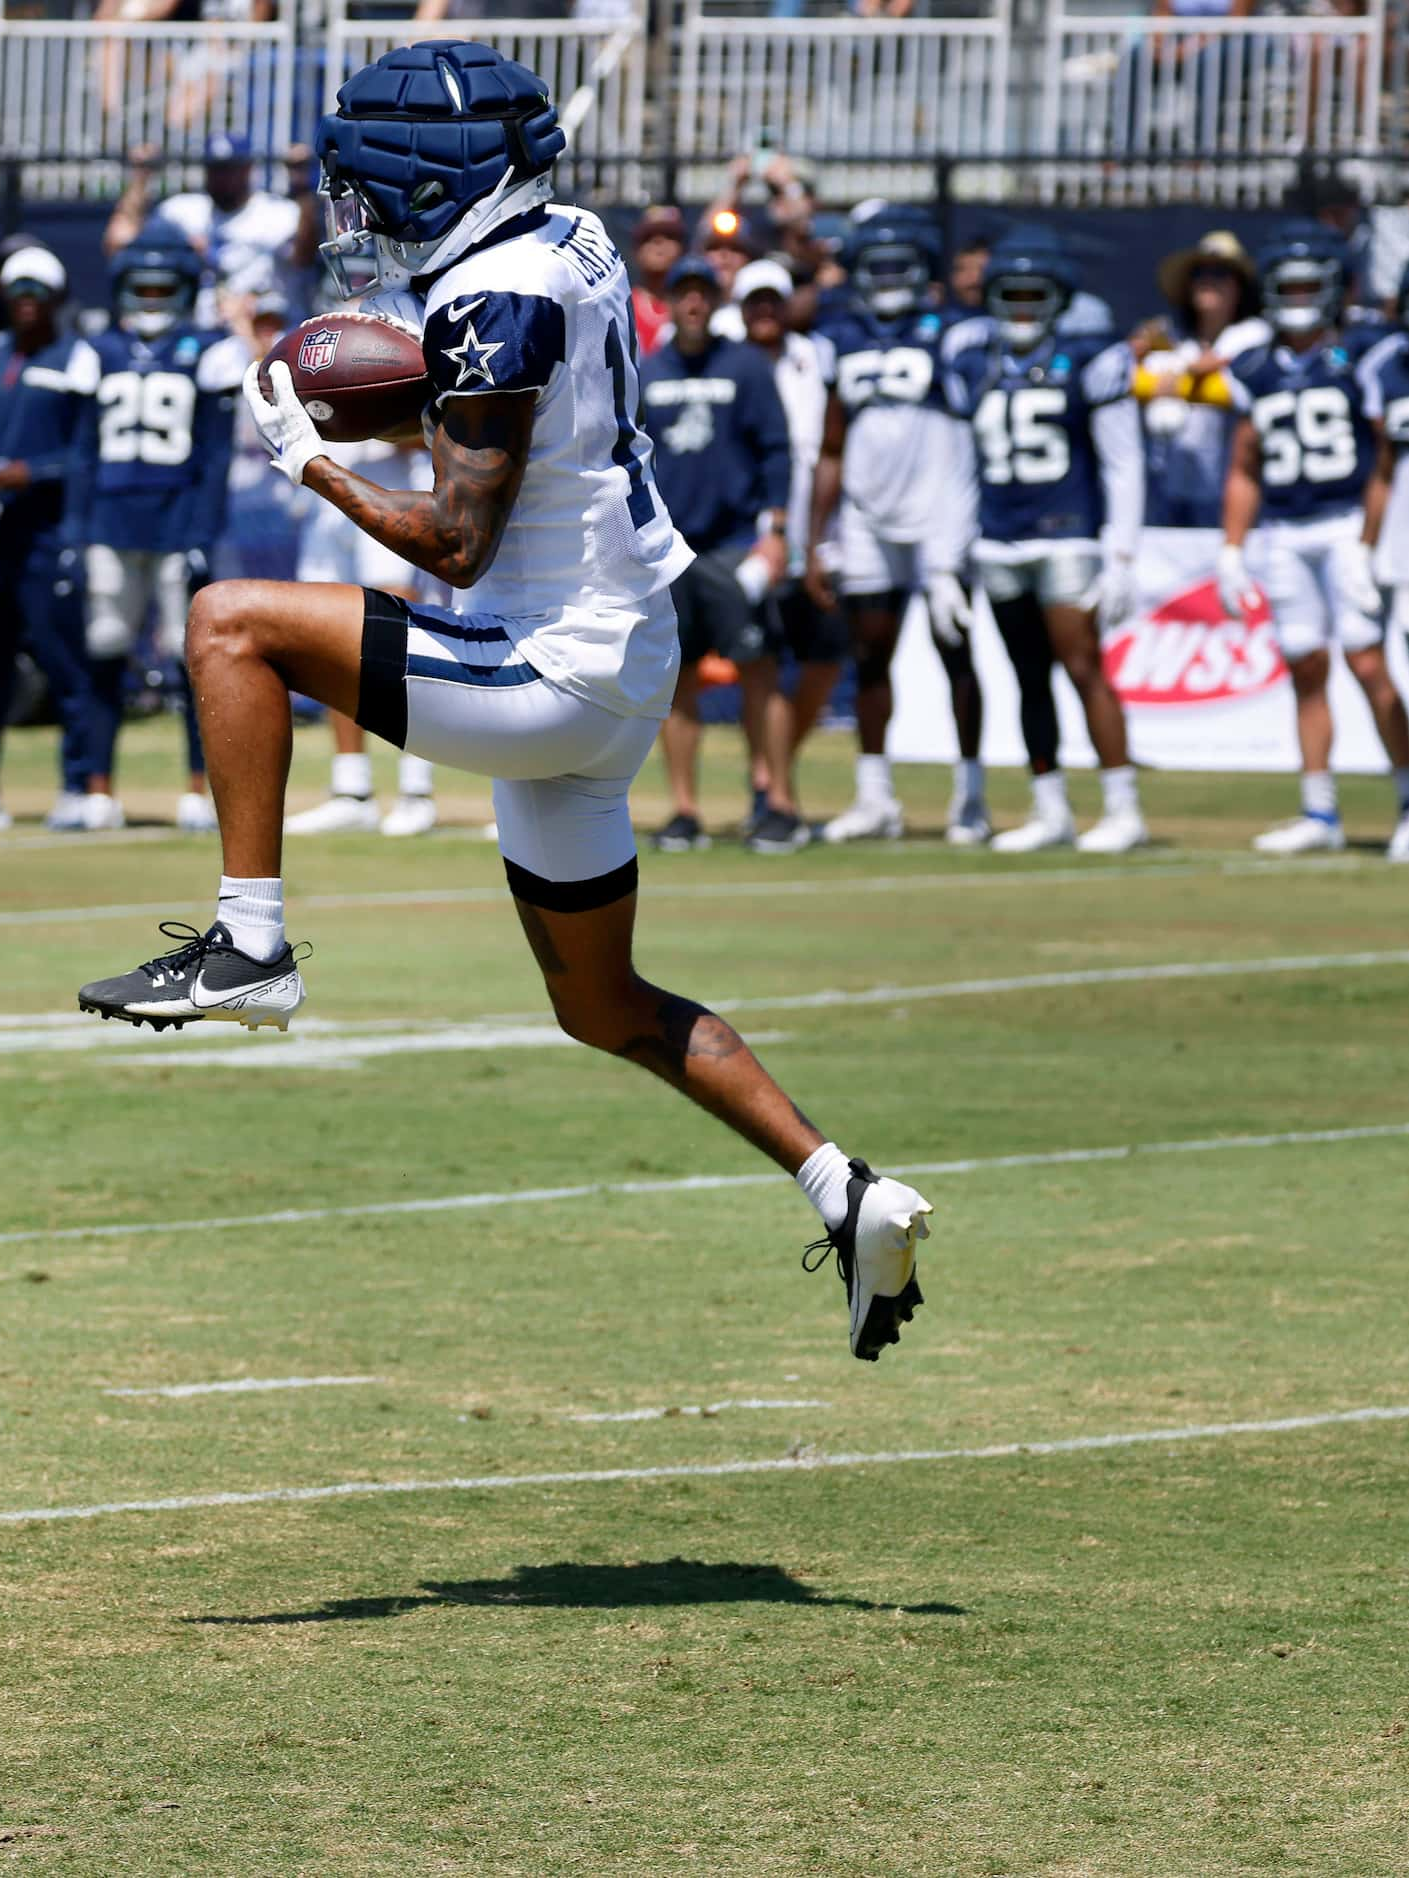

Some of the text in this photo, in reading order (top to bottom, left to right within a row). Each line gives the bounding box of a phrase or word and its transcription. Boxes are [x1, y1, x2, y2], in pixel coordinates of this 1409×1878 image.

[302, 345, 329, 367] NFL
[97, 371, 195, 464] 29
[1252, 386, 1357, 485] 59
[1113, 618, 1276, 692] WSS
